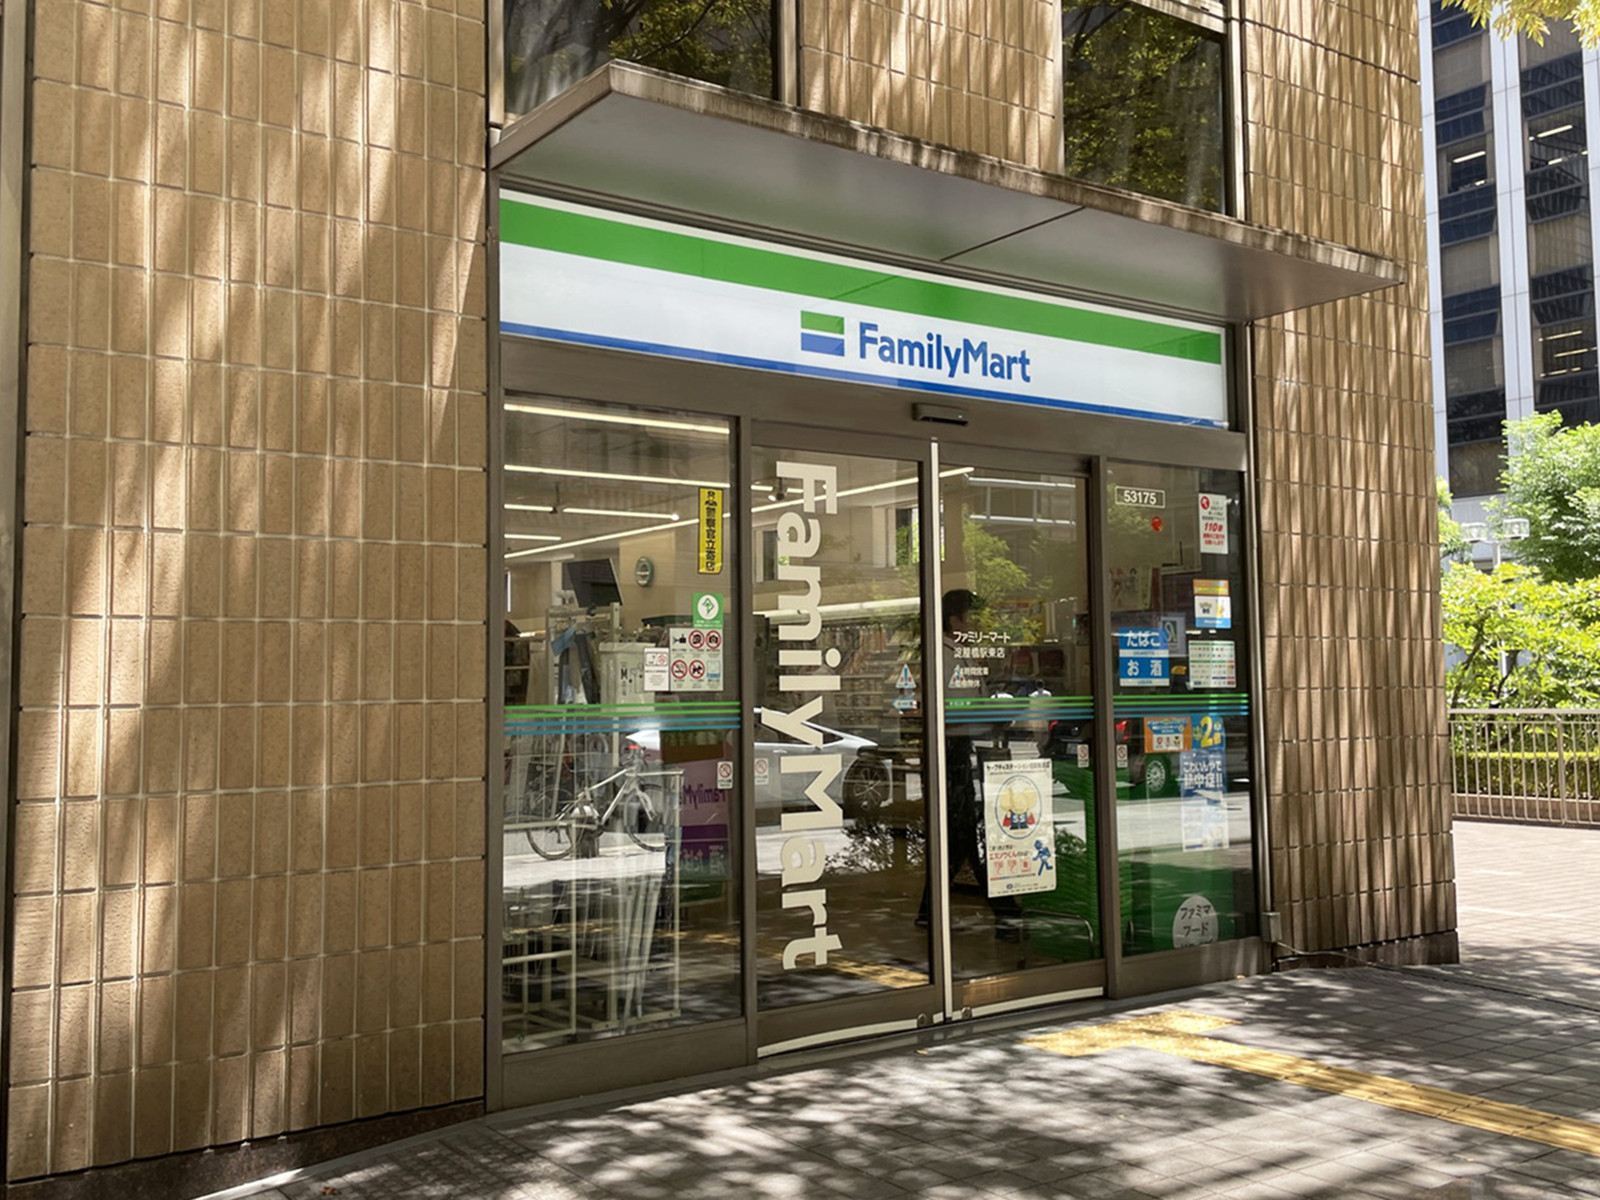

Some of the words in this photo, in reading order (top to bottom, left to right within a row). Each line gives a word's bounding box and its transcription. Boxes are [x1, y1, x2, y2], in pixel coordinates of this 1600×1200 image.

[859, 321, 1031, 383] FamilyMart
[1124, 489, 1157, 505] 53175
[953, 631, 1011, 644] ファミリーマート
[1126, 630, 1161, 647] たばこ
[761, 460, 843, 971] FamilyMart
[1180, 904, 1212, 920] ファミマ
[1183, 921, 1209, 937] フード
